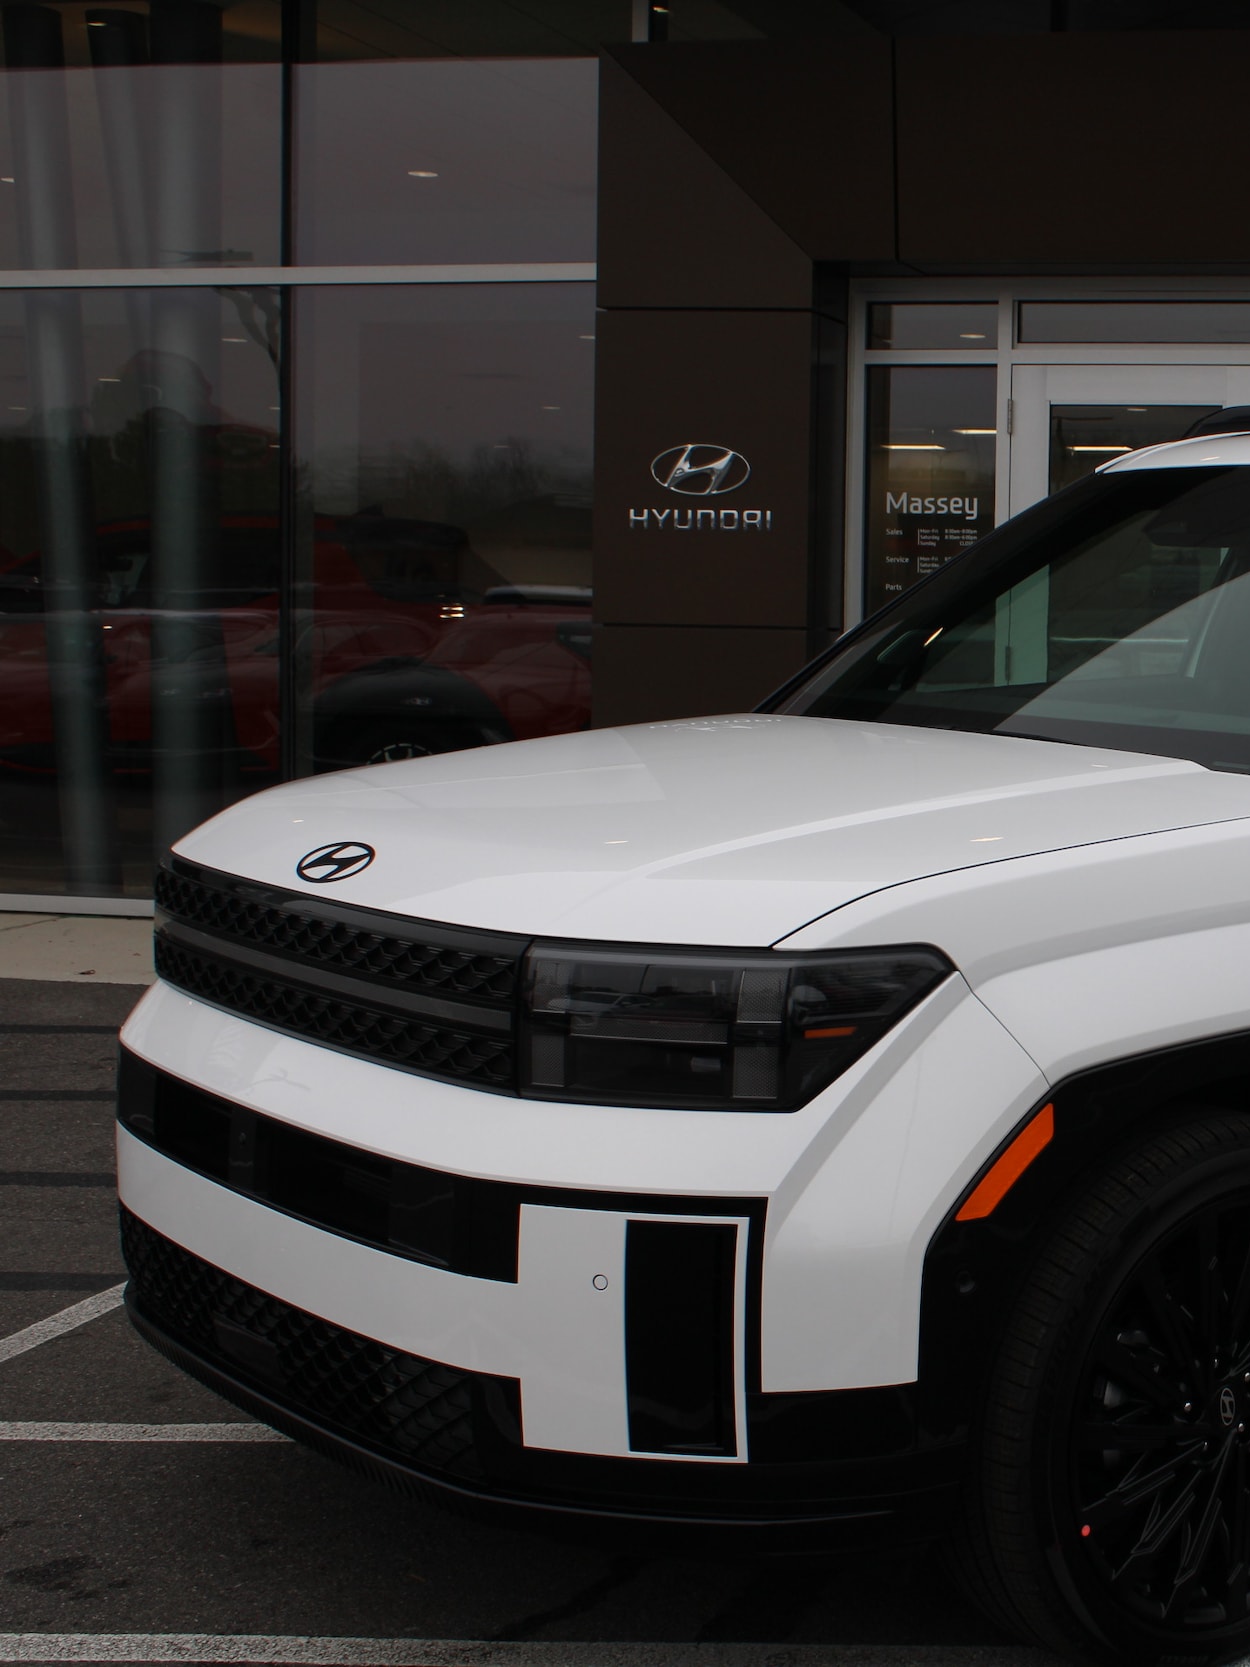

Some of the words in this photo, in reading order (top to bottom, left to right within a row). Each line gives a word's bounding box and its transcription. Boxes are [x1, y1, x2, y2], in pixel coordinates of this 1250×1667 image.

[886, 491, 978, 520] Massey
[629, 508, 772, 530] HYUNDAI
[885, 528, 904, 536] Sales
[885, 583, 903, 591] Parts
